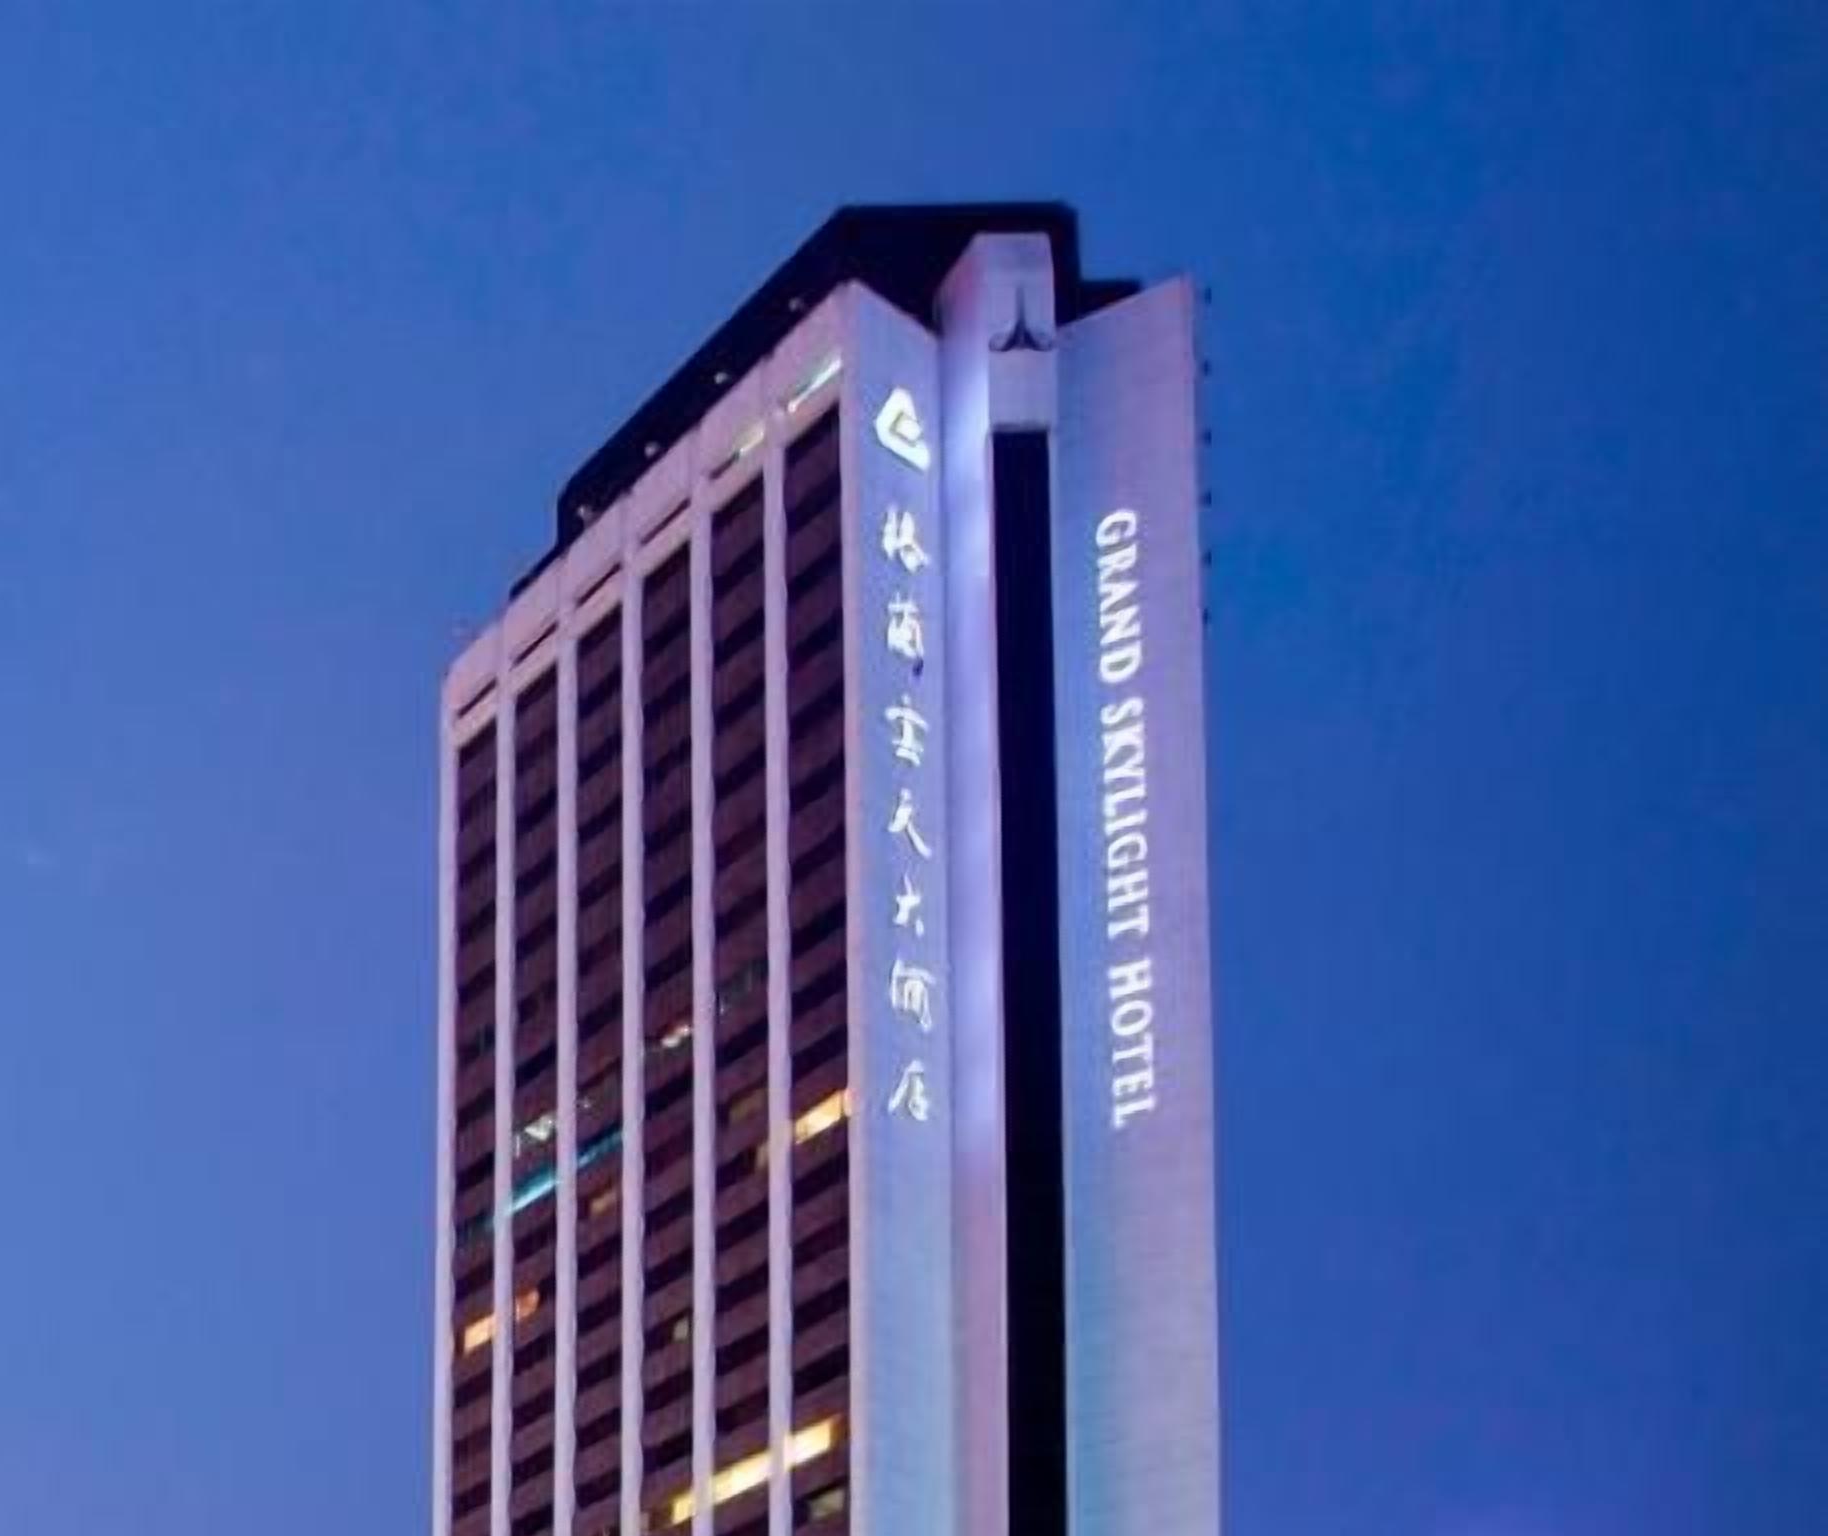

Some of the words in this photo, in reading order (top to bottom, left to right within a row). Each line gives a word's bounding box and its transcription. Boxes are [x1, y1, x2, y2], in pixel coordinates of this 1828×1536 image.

[1095, 508, 1143, 685] GRAND
[1100, 695, 1151, 938] SKYLIGHT
[1108, 956, 1157, 1129] HOTEL
